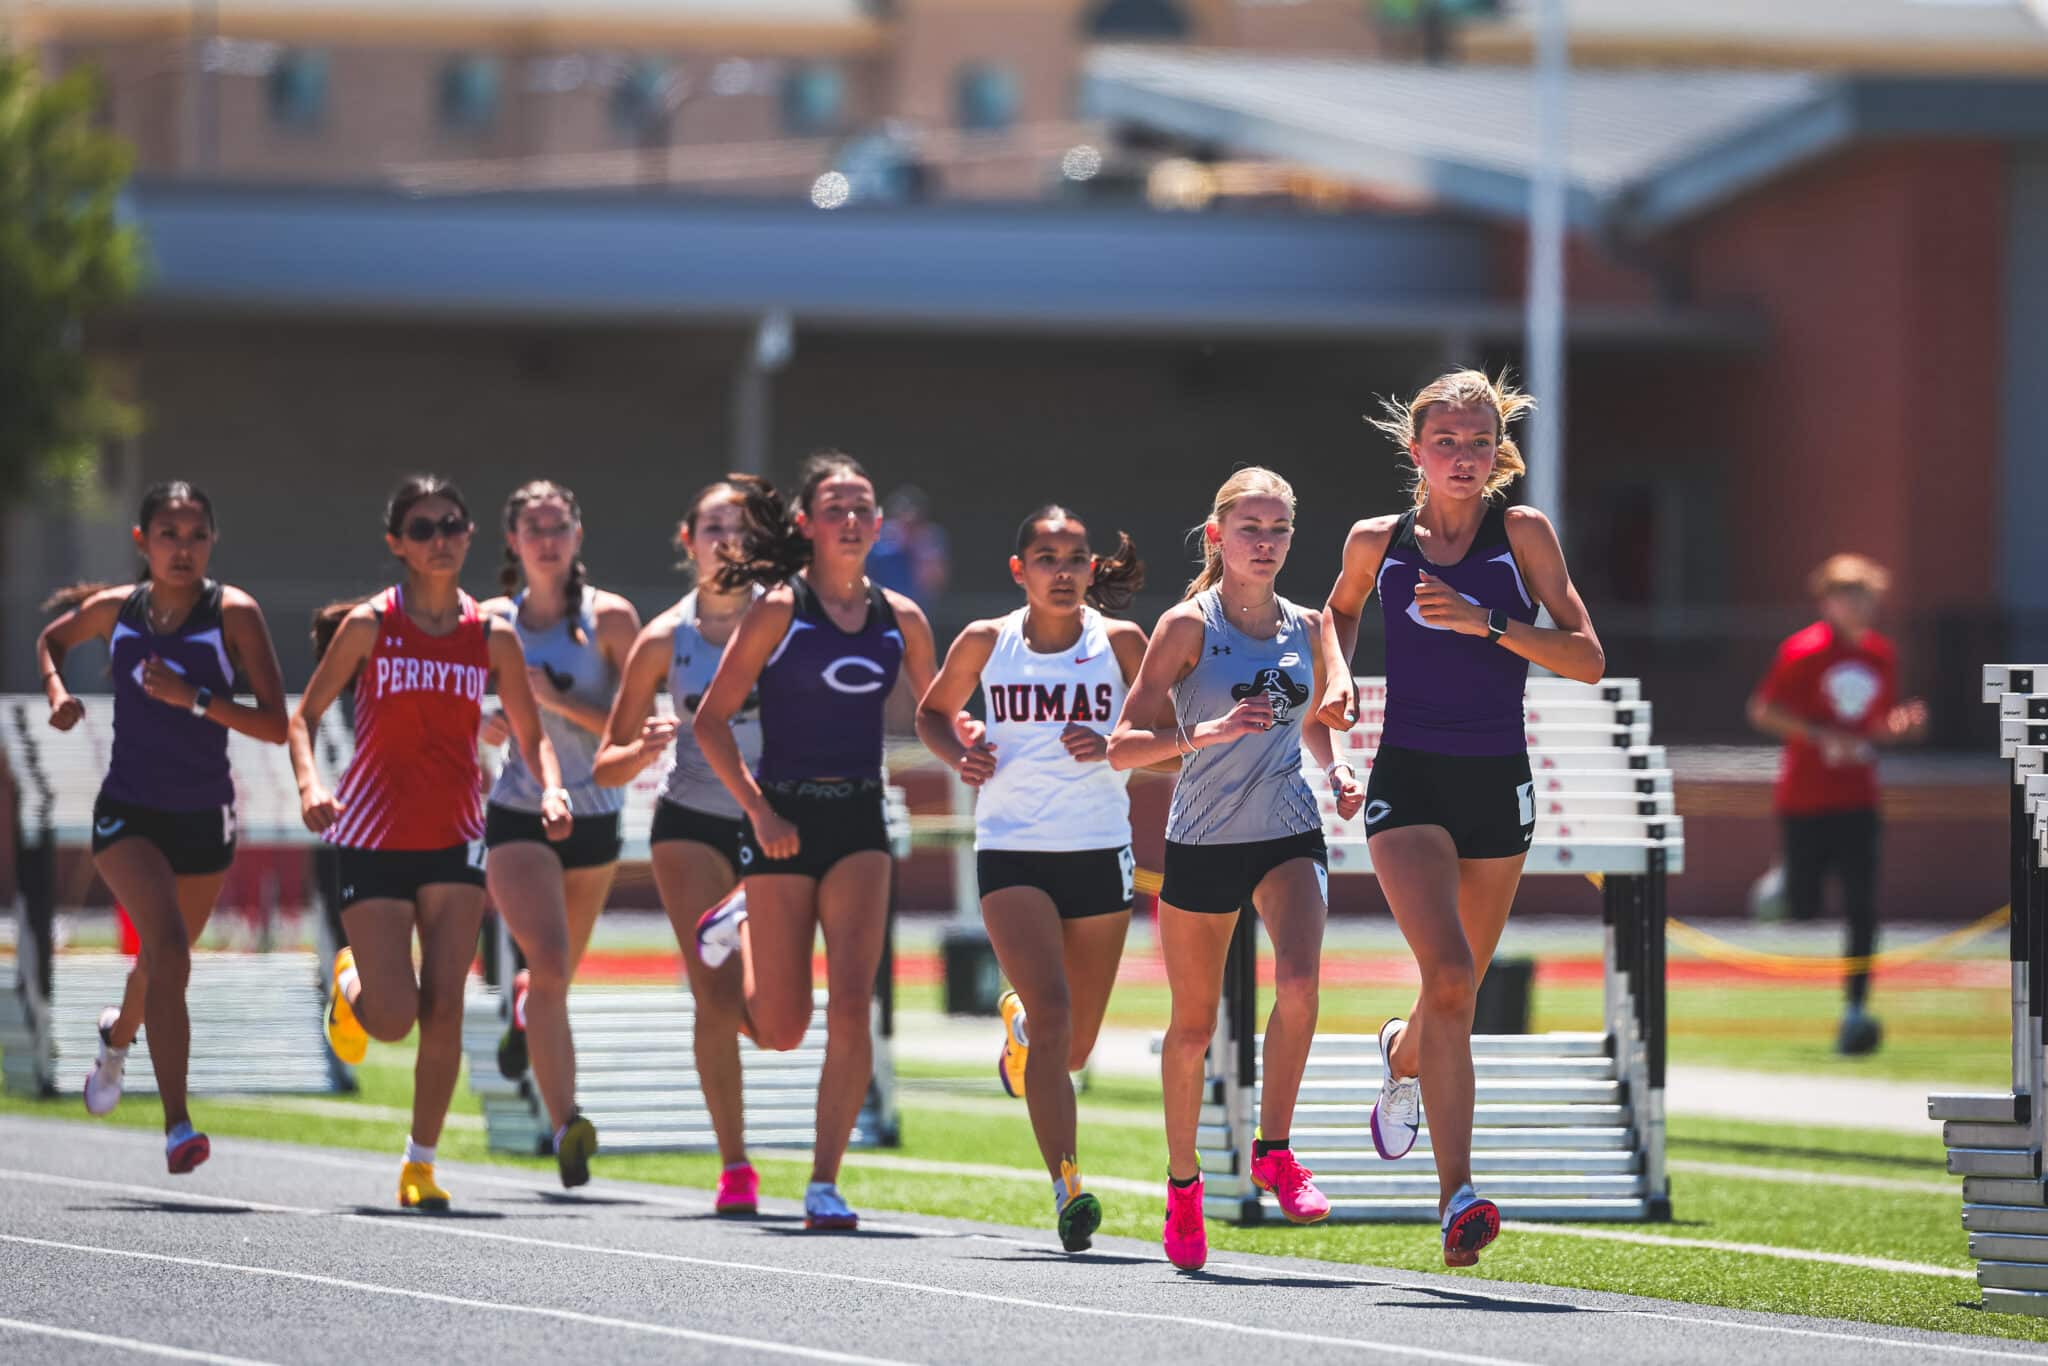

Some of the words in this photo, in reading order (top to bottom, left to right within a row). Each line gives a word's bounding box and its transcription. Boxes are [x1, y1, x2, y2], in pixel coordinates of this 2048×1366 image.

[822, 656, 885, 694] C
[1264, 669, 1289, 693] R
[989, 683, 1112, 724] DUMAS
